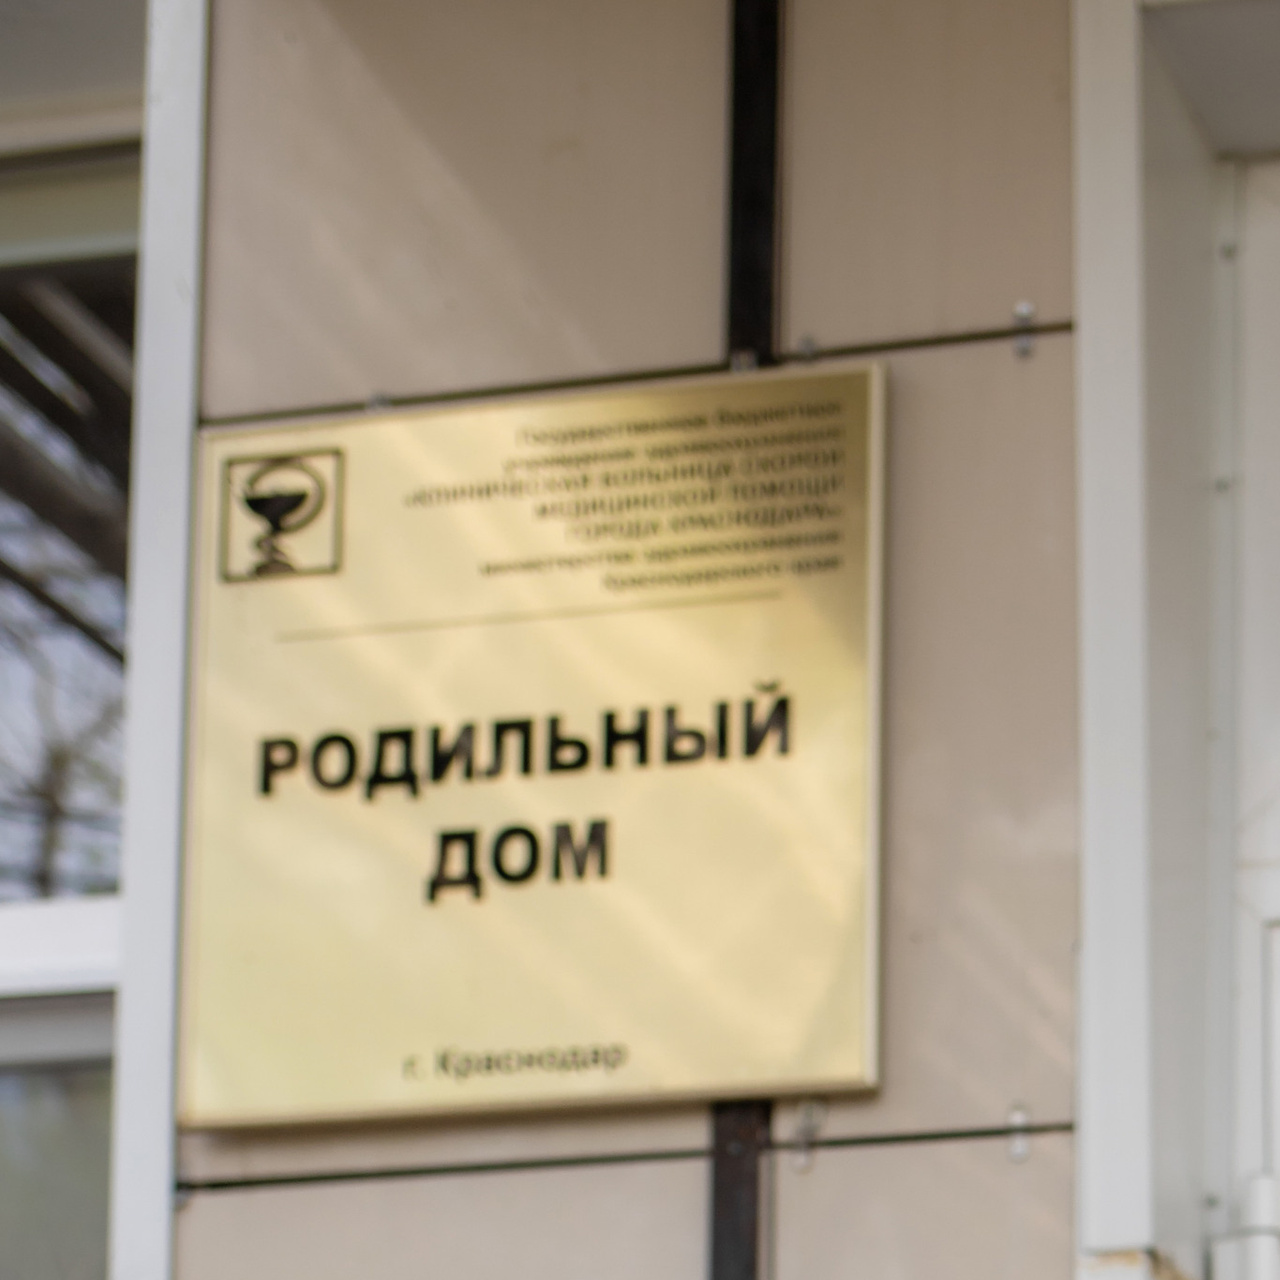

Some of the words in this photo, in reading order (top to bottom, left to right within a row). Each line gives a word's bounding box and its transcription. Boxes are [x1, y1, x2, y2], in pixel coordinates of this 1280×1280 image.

[258, 681, 792, 801] РОДИЛЬНЫЙ
[426, 820, 610, 902] ДОМ
[434, 1043, 630, 1083] Краснодар
